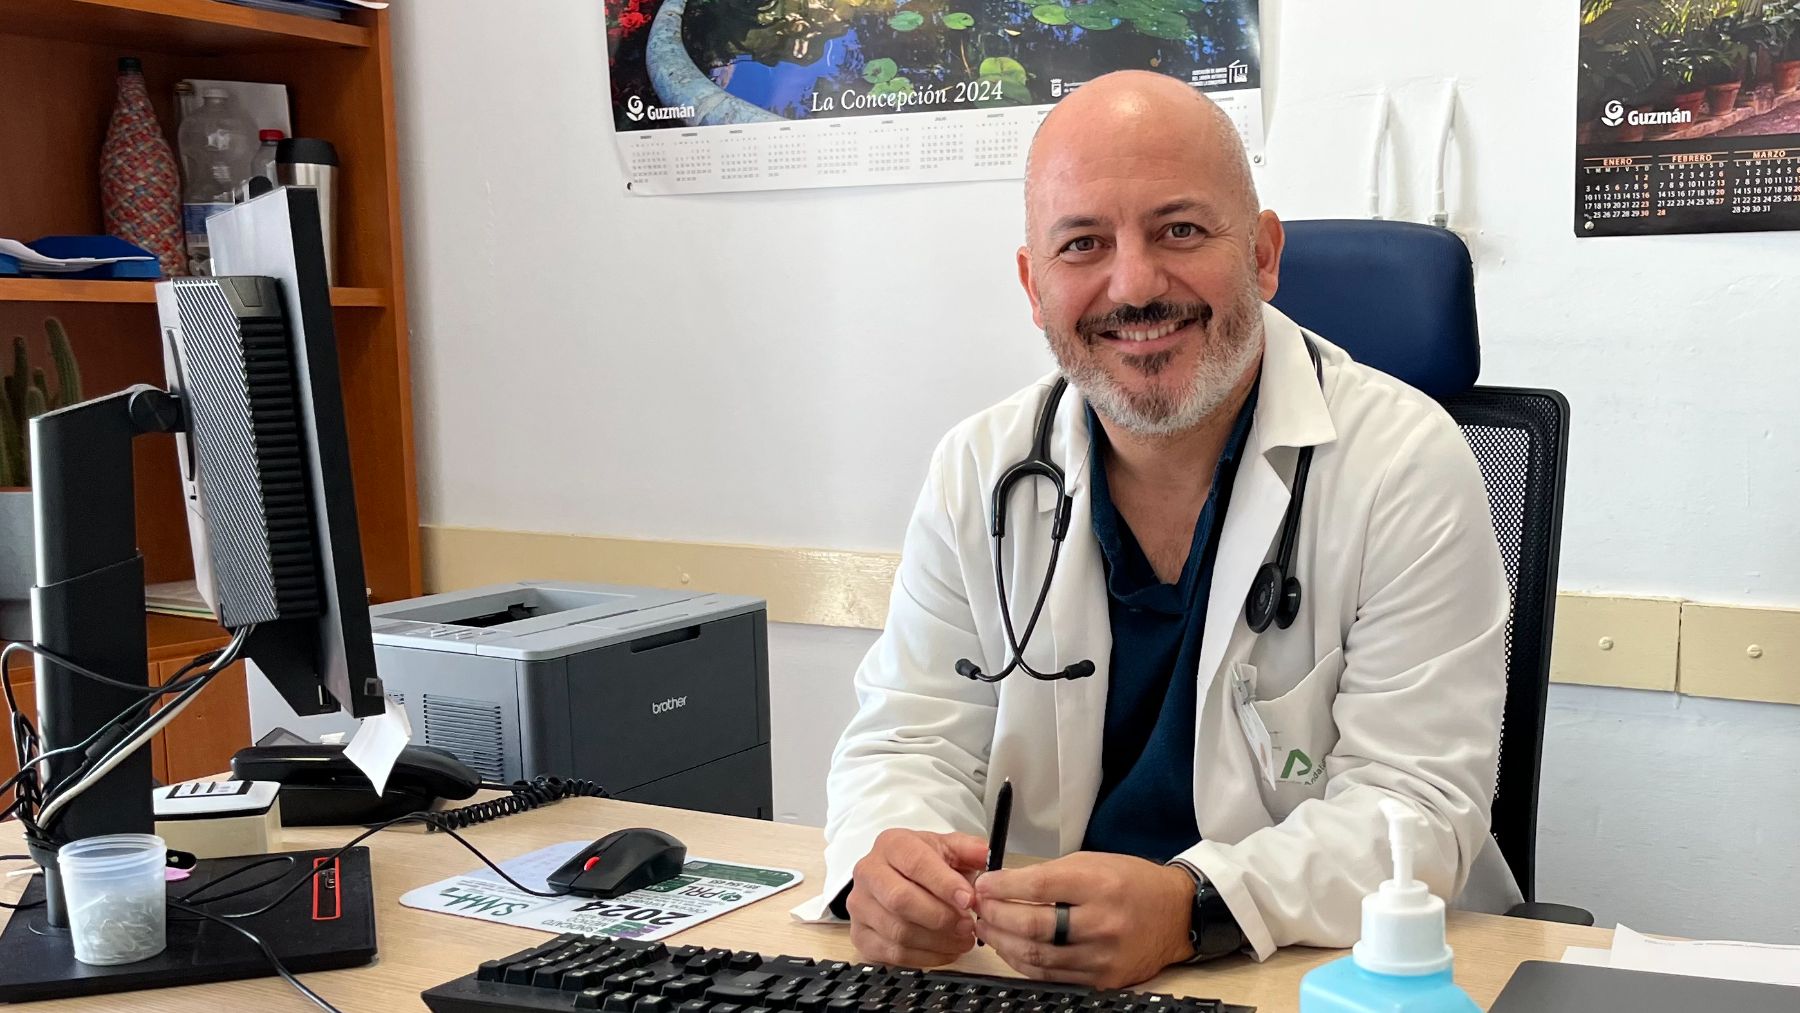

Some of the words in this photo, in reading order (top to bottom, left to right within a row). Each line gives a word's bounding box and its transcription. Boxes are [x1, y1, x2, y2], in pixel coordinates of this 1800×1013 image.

[811, 92, 834, 111] La
[841, 84, 947, 111] Concepción
[954, 80, 1003, 103] 2024
[647, 104, 695, 120] Guzmán
[1628, 108, 1691, 126] Guzmán
[1672, 154, 1712, 162] FEBRERO
[1753, 150, 1786, 158] MARZO
[1603, 158, 1633, 166] ENERO
[1765, 177, 1772, 185] 10
[1774, 186, 1782, 194] 18
[1687, 199, 1694, 207] 24
[1733, 197, 1740, 205] 21
[1773, 195, 1781, 203] 25
[1783, 195, 1792, 203] 26
[1732, 206, 1740, 214] 28
[1742, 206, 1750, 214] 29
[1763, 205, 1770, 213] 31
[652, 696, 687, 714] brother
[678, 885, 725, 899] PRL
[571, 901, 693, 925] 2024
